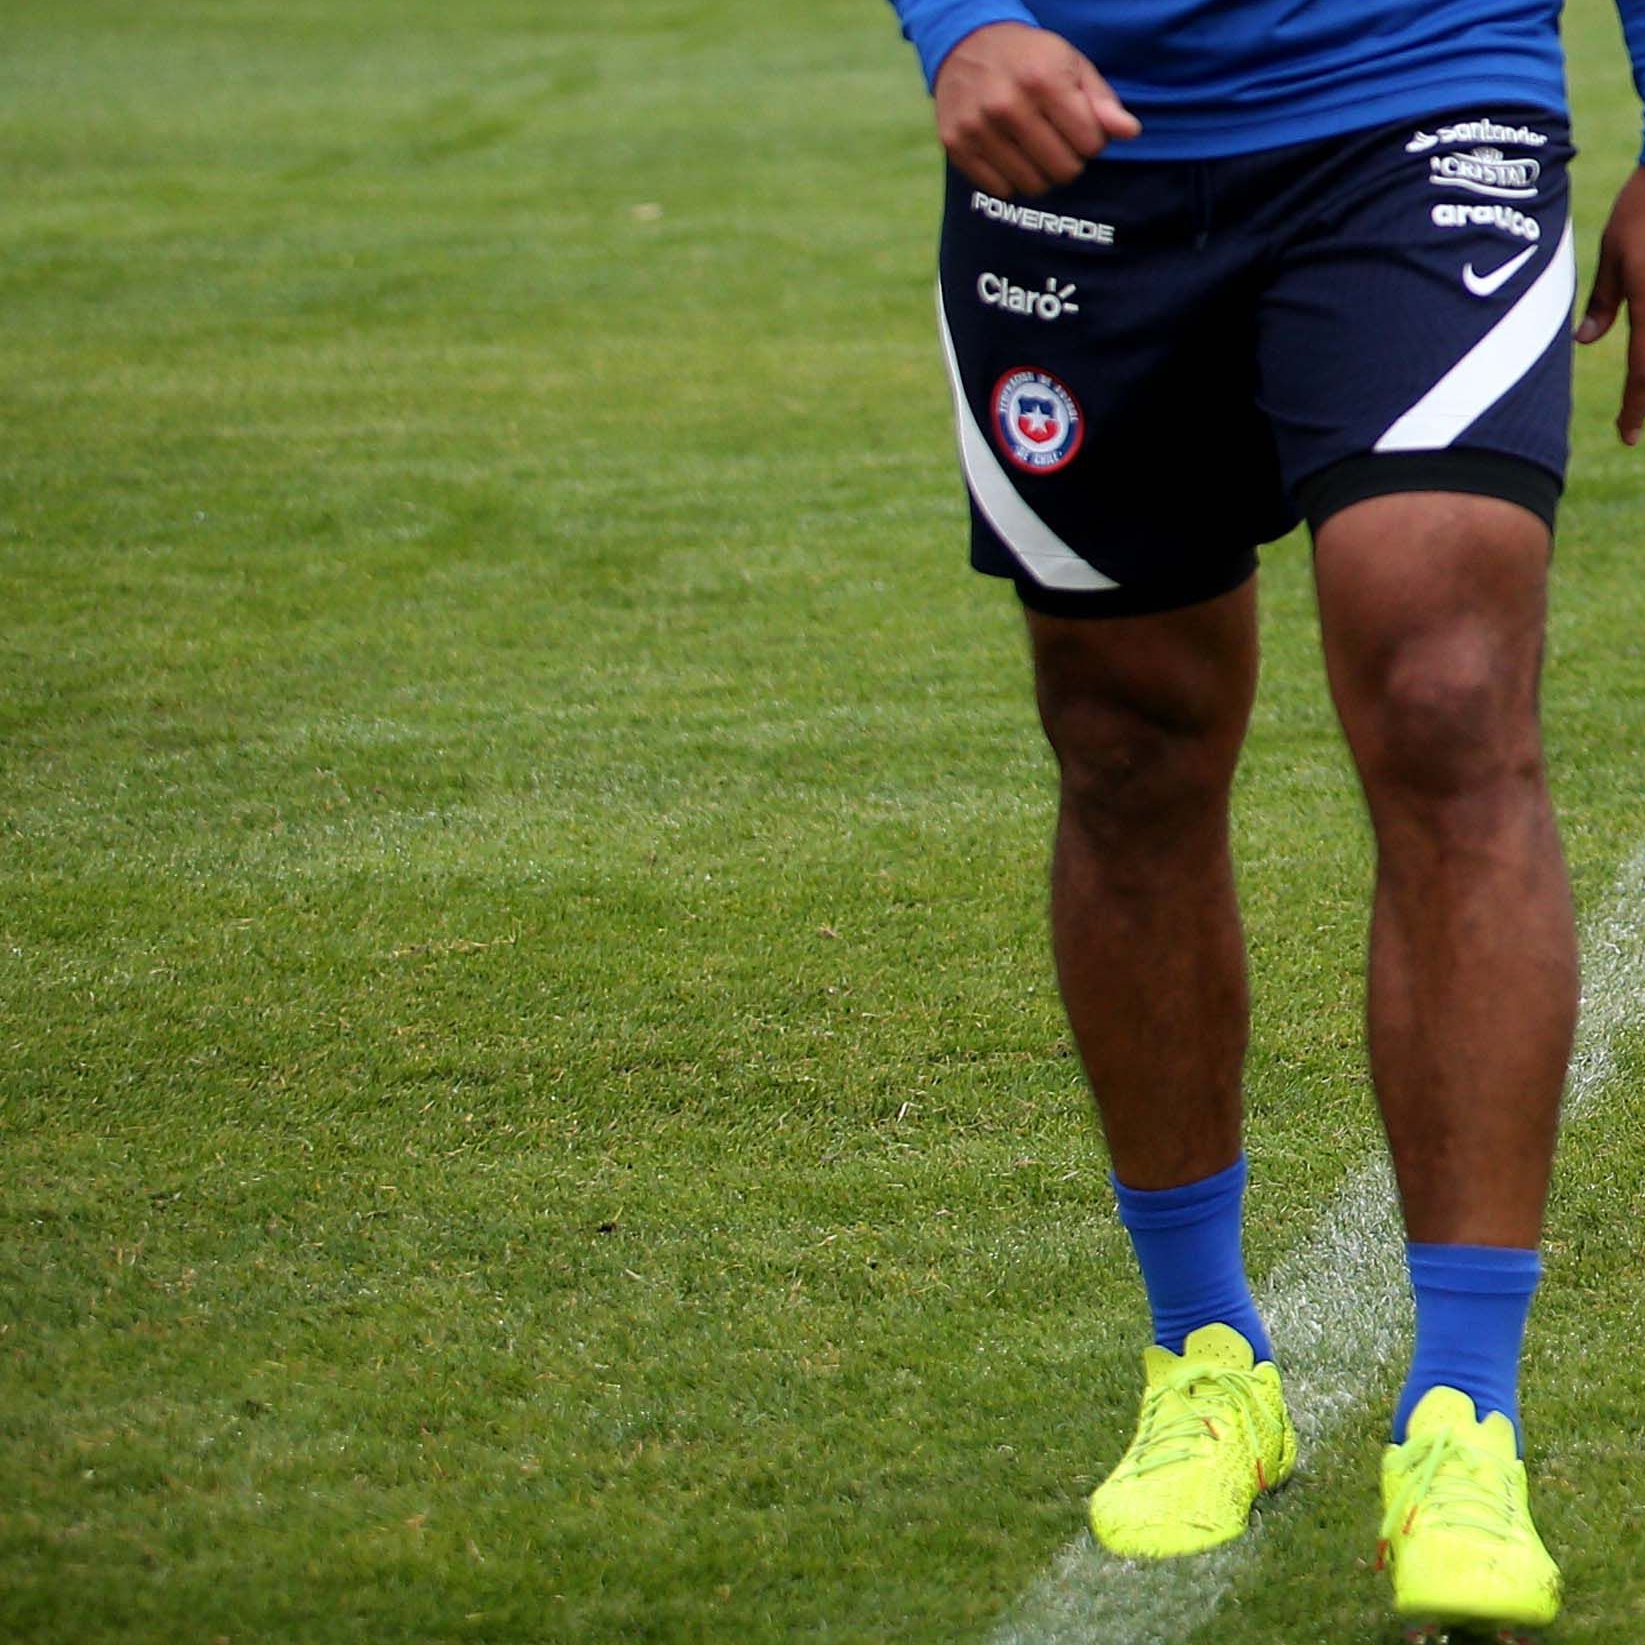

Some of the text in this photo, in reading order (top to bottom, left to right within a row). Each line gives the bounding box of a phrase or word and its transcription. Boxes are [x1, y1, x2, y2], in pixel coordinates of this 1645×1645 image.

[973, 190, 1115, 244] POWERADE
[1431, 203, 1541, 242] arauco
[976, 271, 1062, 320] Claro
